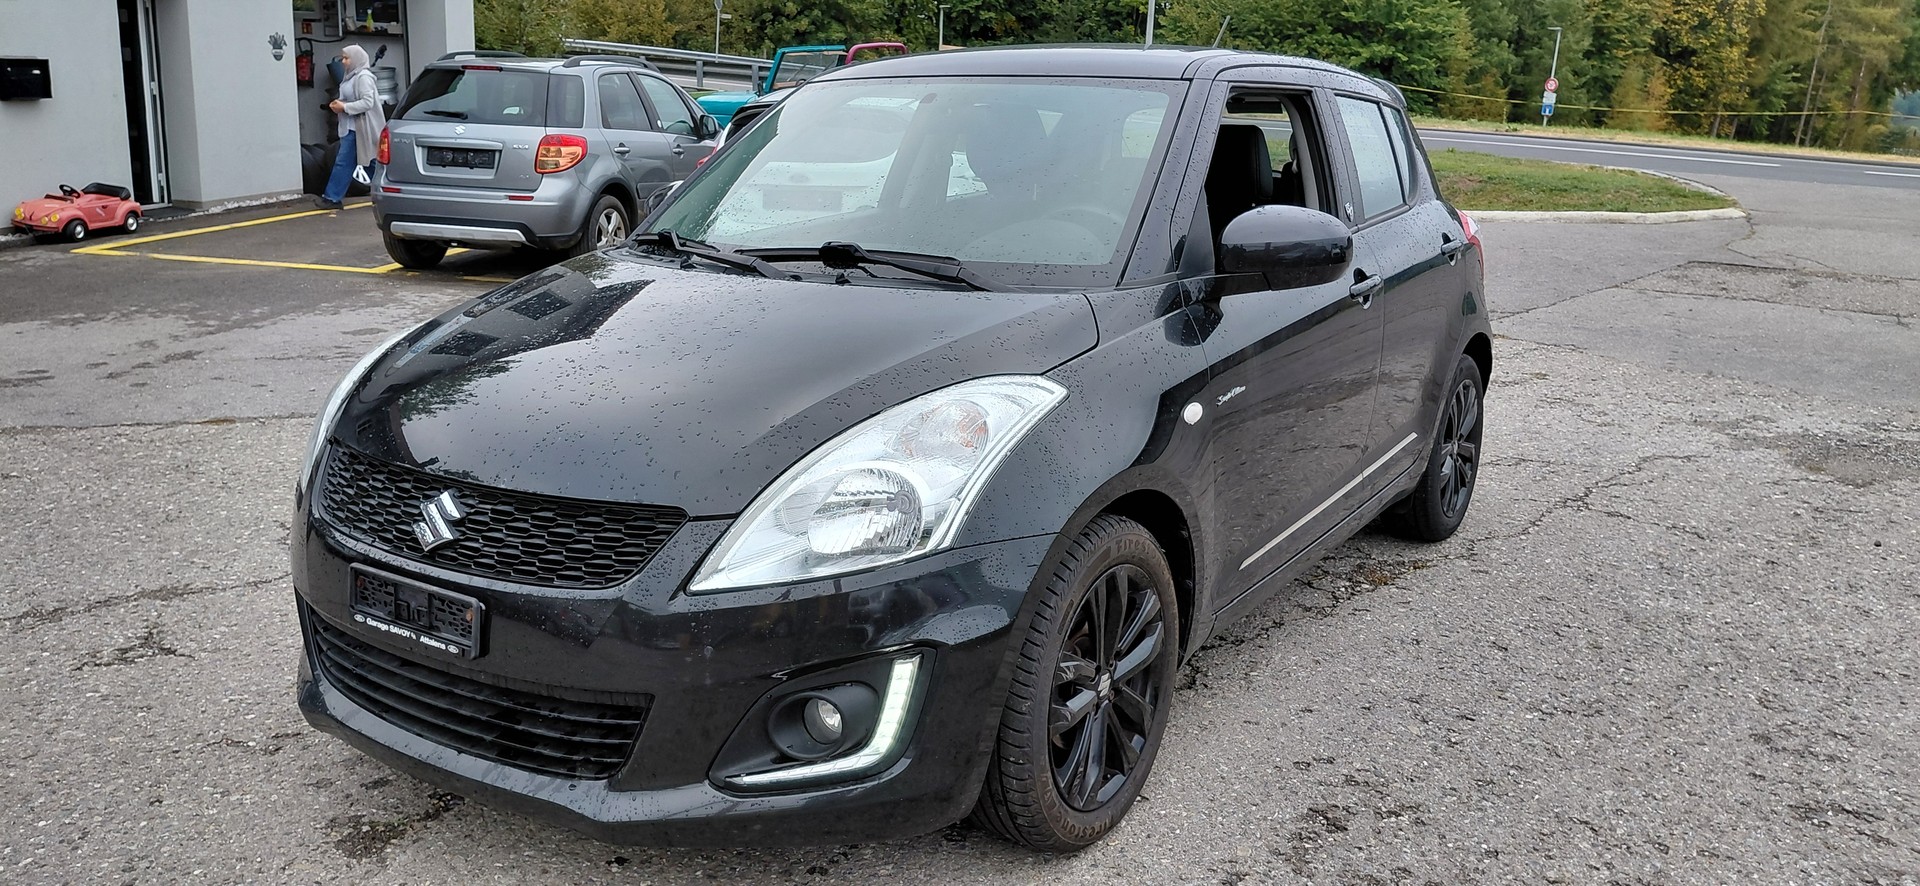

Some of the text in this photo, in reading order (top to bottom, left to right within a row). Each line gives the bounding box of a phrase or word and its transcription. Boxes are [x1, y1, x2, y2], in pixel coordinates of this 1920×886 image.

[366, 617, 389, 631] Garage
[389, 625, 411, 638] SAVOY
[419, 635, 446, 650] Attalens
